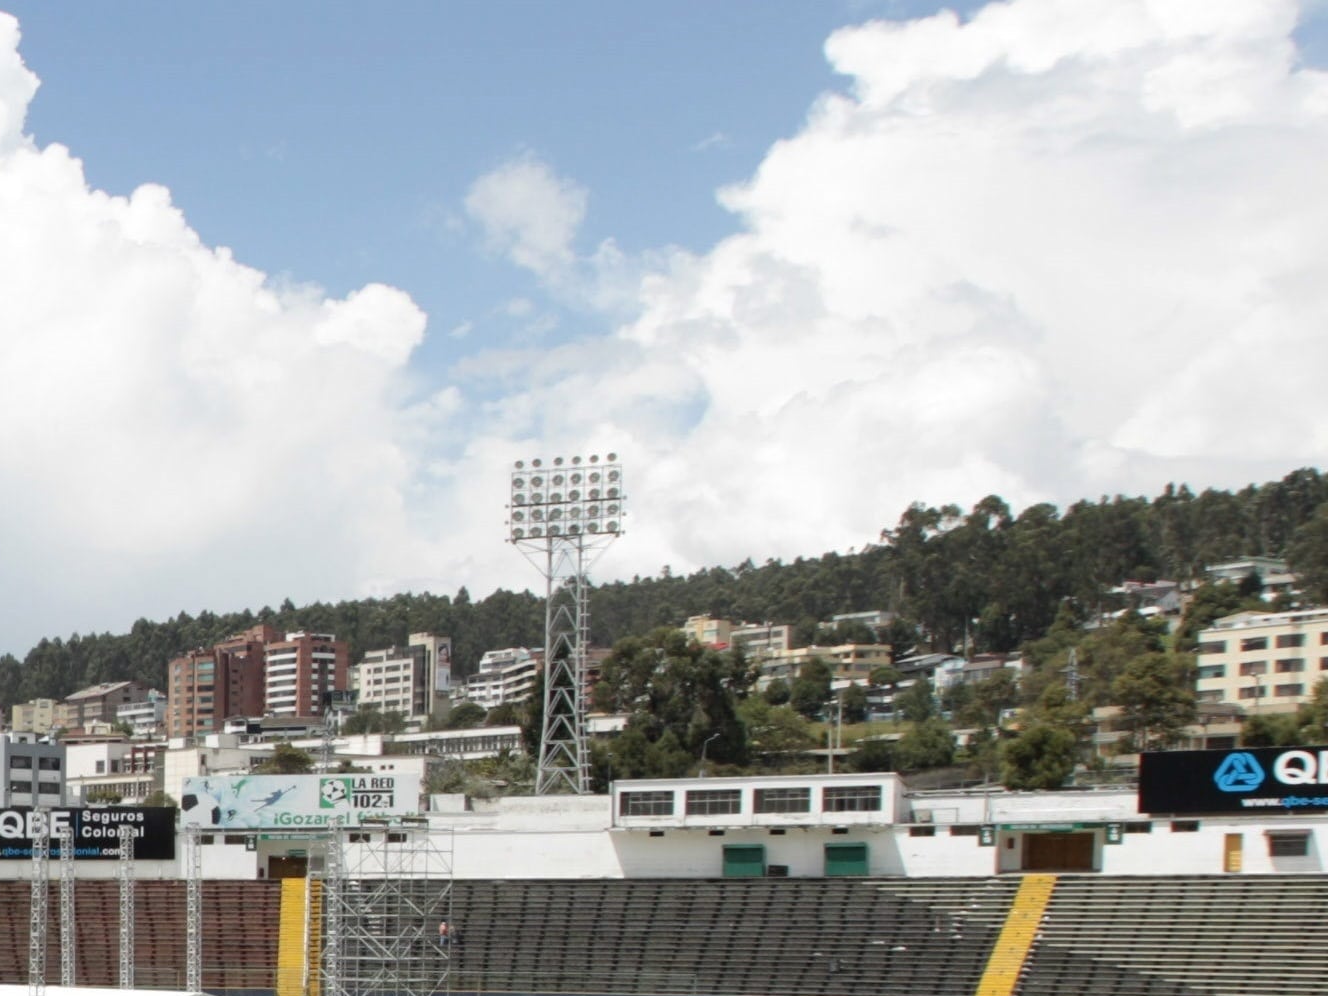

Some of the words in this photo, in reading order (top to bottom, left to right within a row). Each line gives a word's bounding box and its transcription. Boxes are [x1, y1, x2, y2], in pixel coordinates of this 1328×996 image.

[352, 778, 366, 788] LA
[371, 778, 394, 788] RED
[82, 810, 144, 824] Seguros
[82, 826, 144, 838] Colonal
